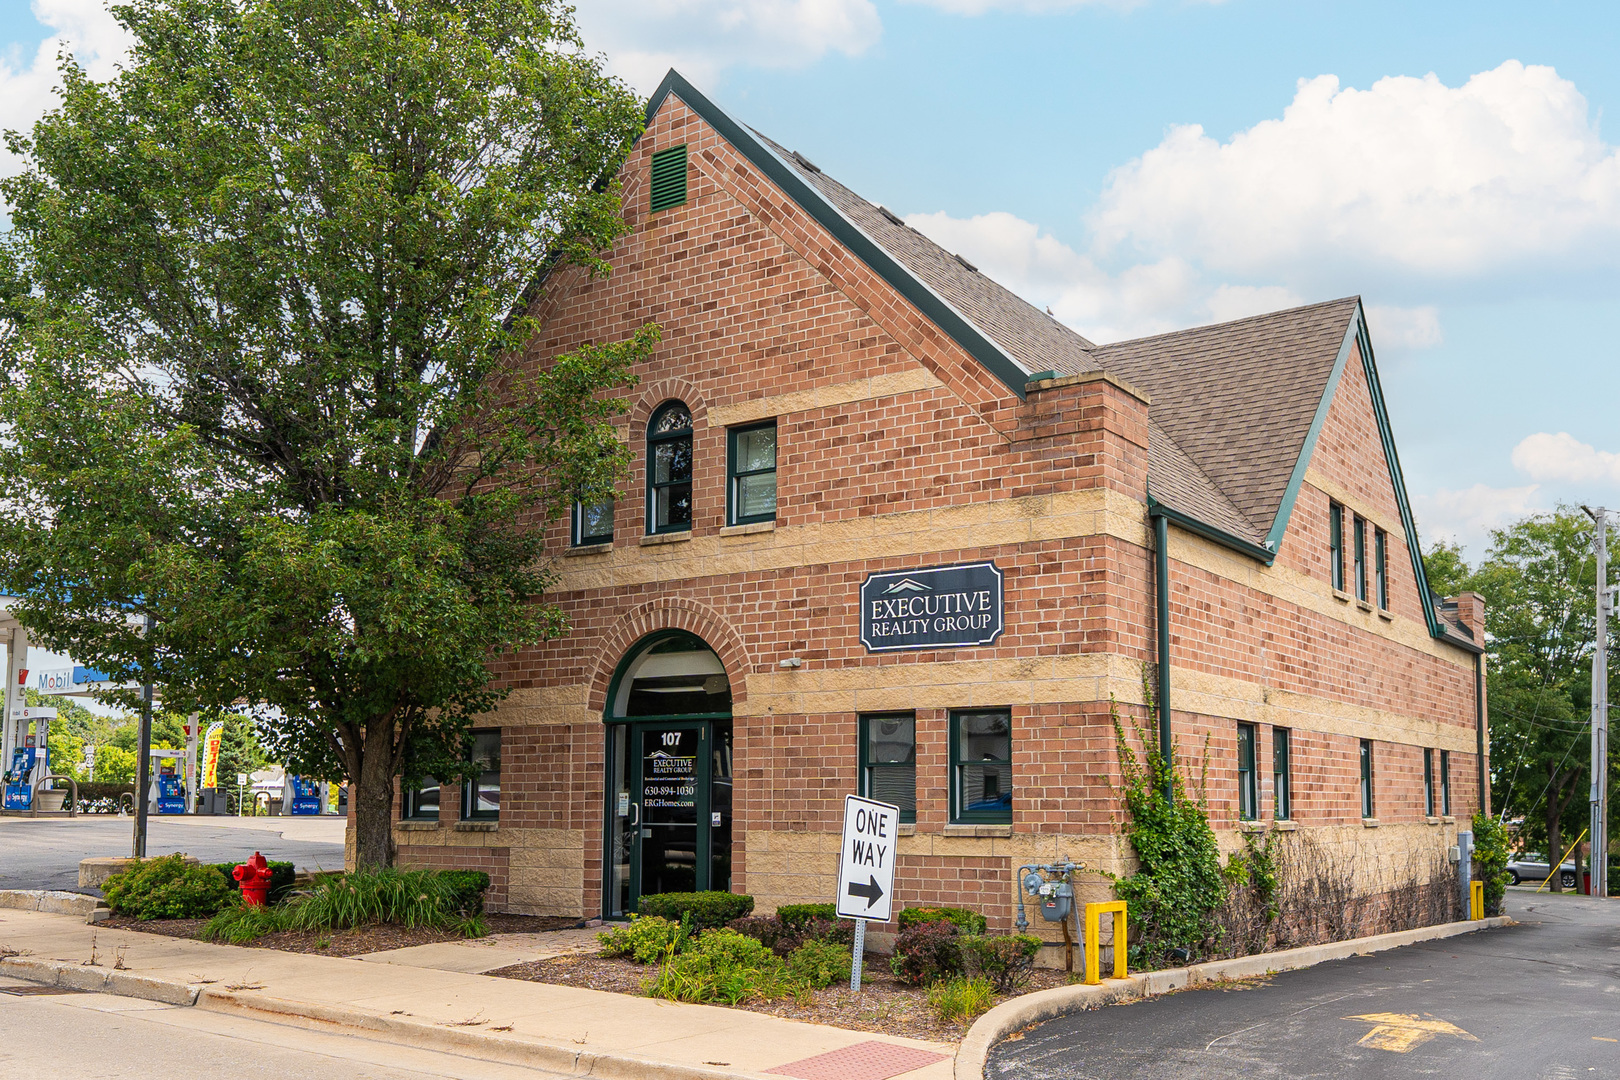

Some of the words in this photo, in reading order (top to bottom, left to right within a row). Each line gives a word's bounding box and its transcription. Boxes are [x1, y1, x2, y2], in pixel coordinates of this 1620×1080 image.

[871, 590, 992, 620] EXECUTIVE
[871, 618, 930, 637] REALTY
[933, 613, 992, 632] GROUP
[38, 671, 70, 689] Mobil
[23, 709, 29, 717] 6
[661, 732, 682, 746] 107
[654, 759, 692, 767] EXECUTIVE
[645, 786, 694, 795] 630-894-1030
[12, 793, 28, 803] Synrgy
[645, 799, 694, 807] ERGHomes.com
[856, 808, 888, 838] ONE
[853, 839, 887, 868] WAY
